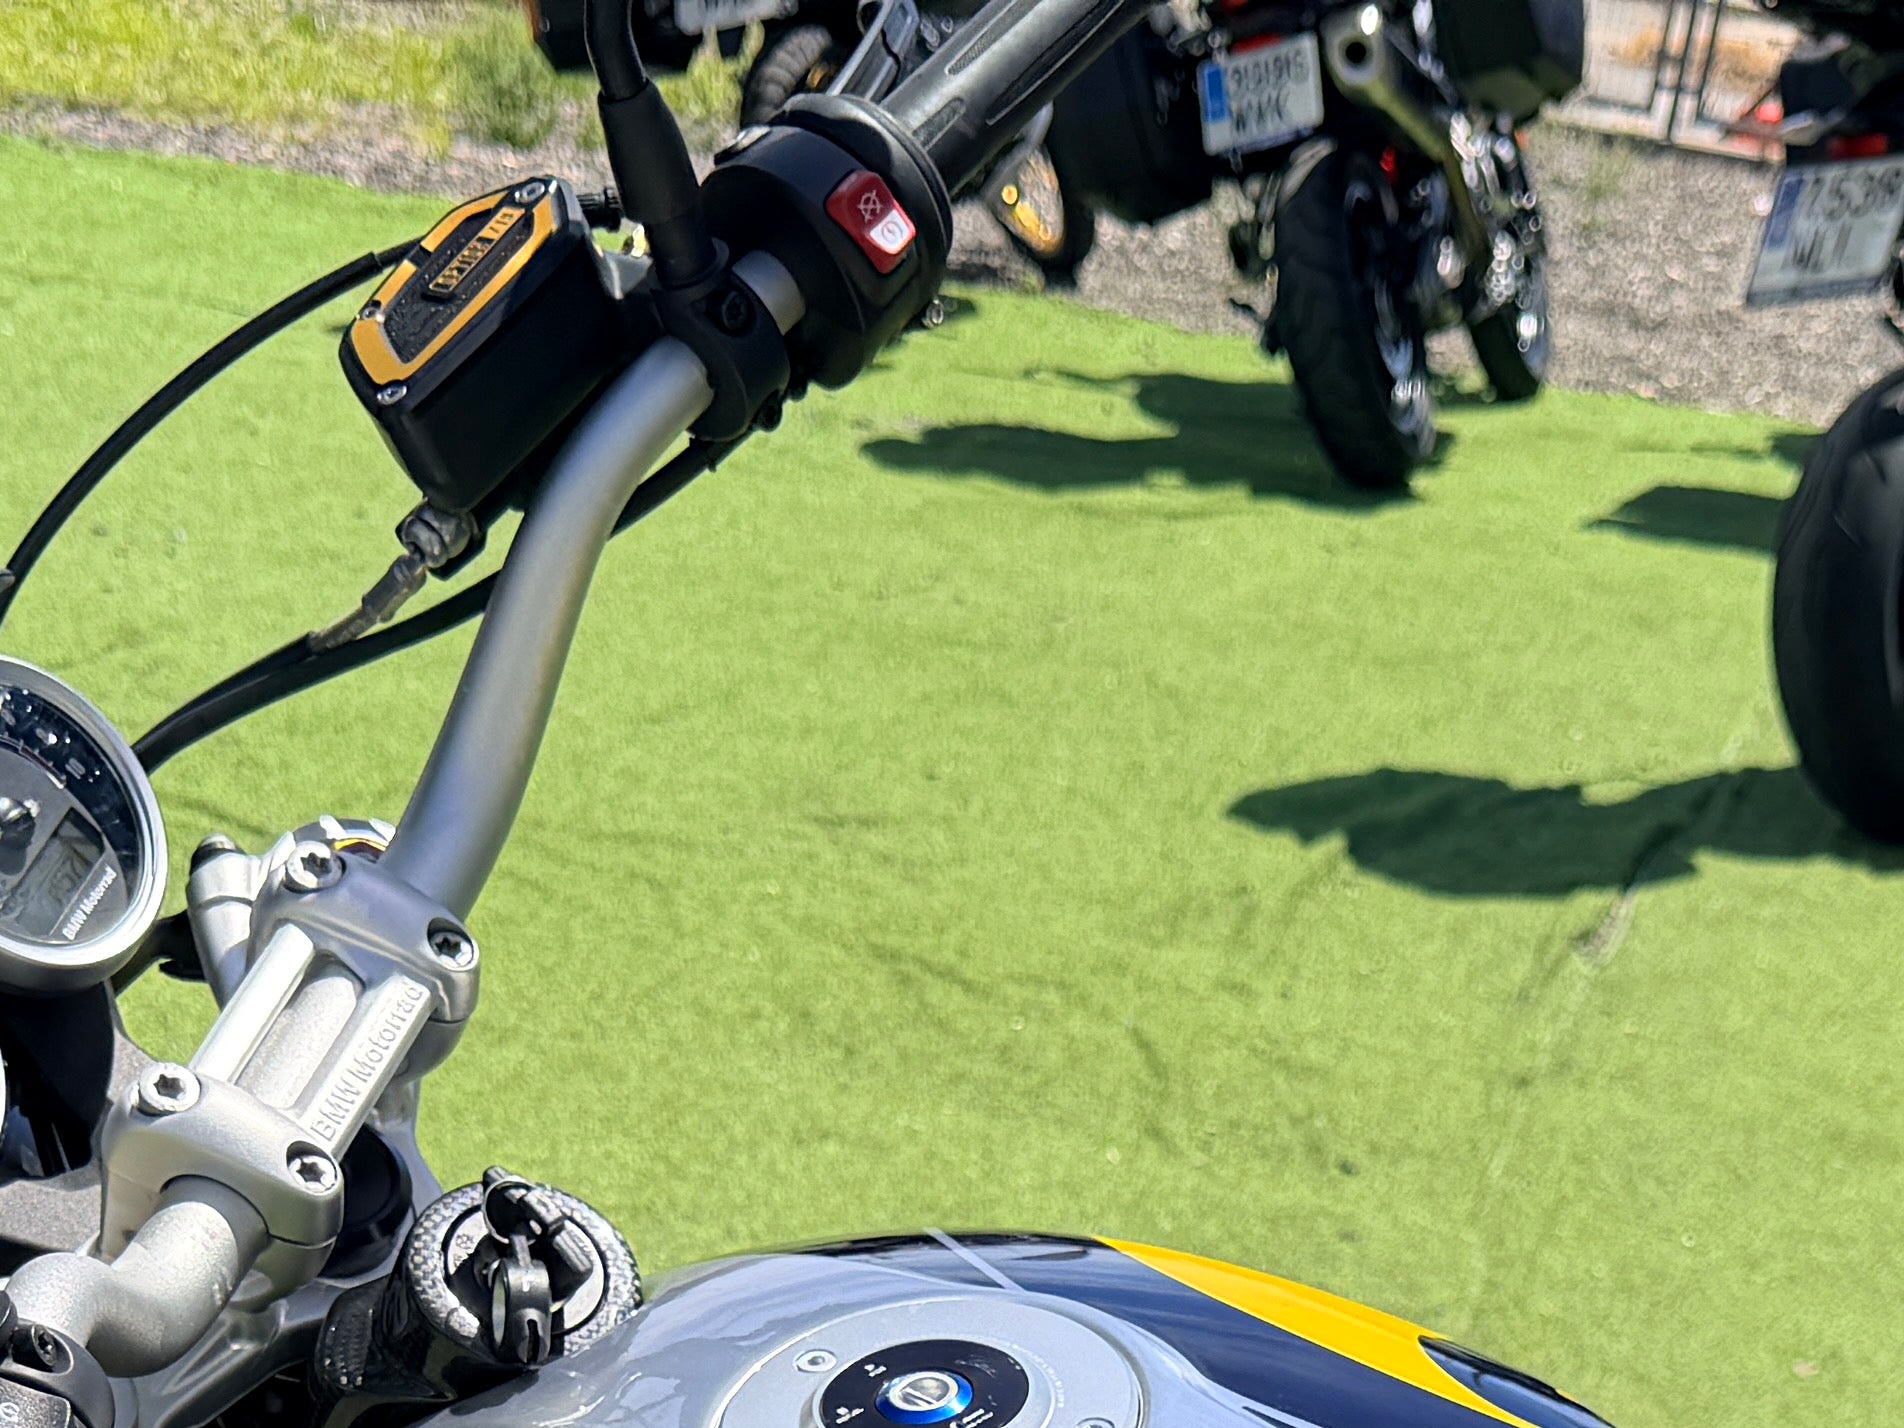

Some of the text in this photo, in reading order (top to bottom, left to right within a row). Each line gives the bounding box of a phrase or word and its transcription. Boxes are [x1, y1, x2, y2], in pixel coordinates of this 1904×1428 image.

[61, 908, 88, 941] BMW
[80, 865, 117, 914] Motorrad
[310, 982, 423, 1142] BMW Motorrad
